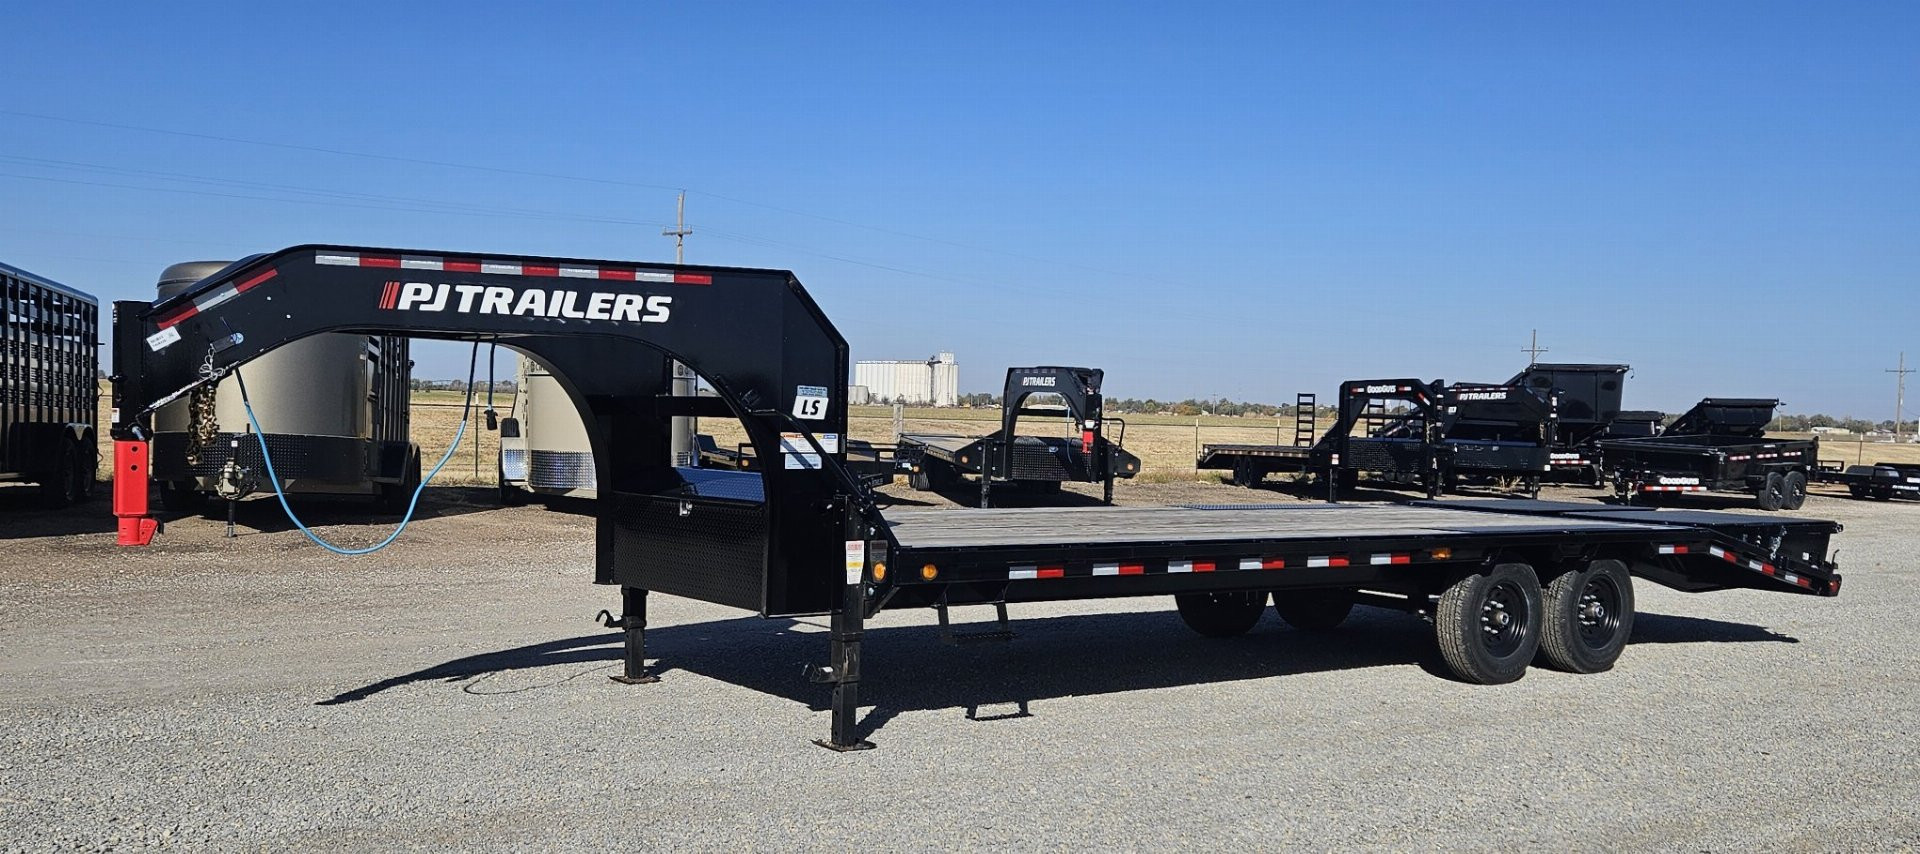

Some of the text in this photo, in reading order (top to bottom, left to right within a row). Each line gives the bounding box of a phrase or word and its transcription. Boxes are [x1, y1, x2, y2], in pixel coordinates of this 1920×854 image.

[398, 282, 673, 323] PJ TRAILERS
[1029, 376, 1056, 387] TRAILERS
[1468, 392, 1507, 400] TRAILERS
[801, 399, 821, 416] LS
